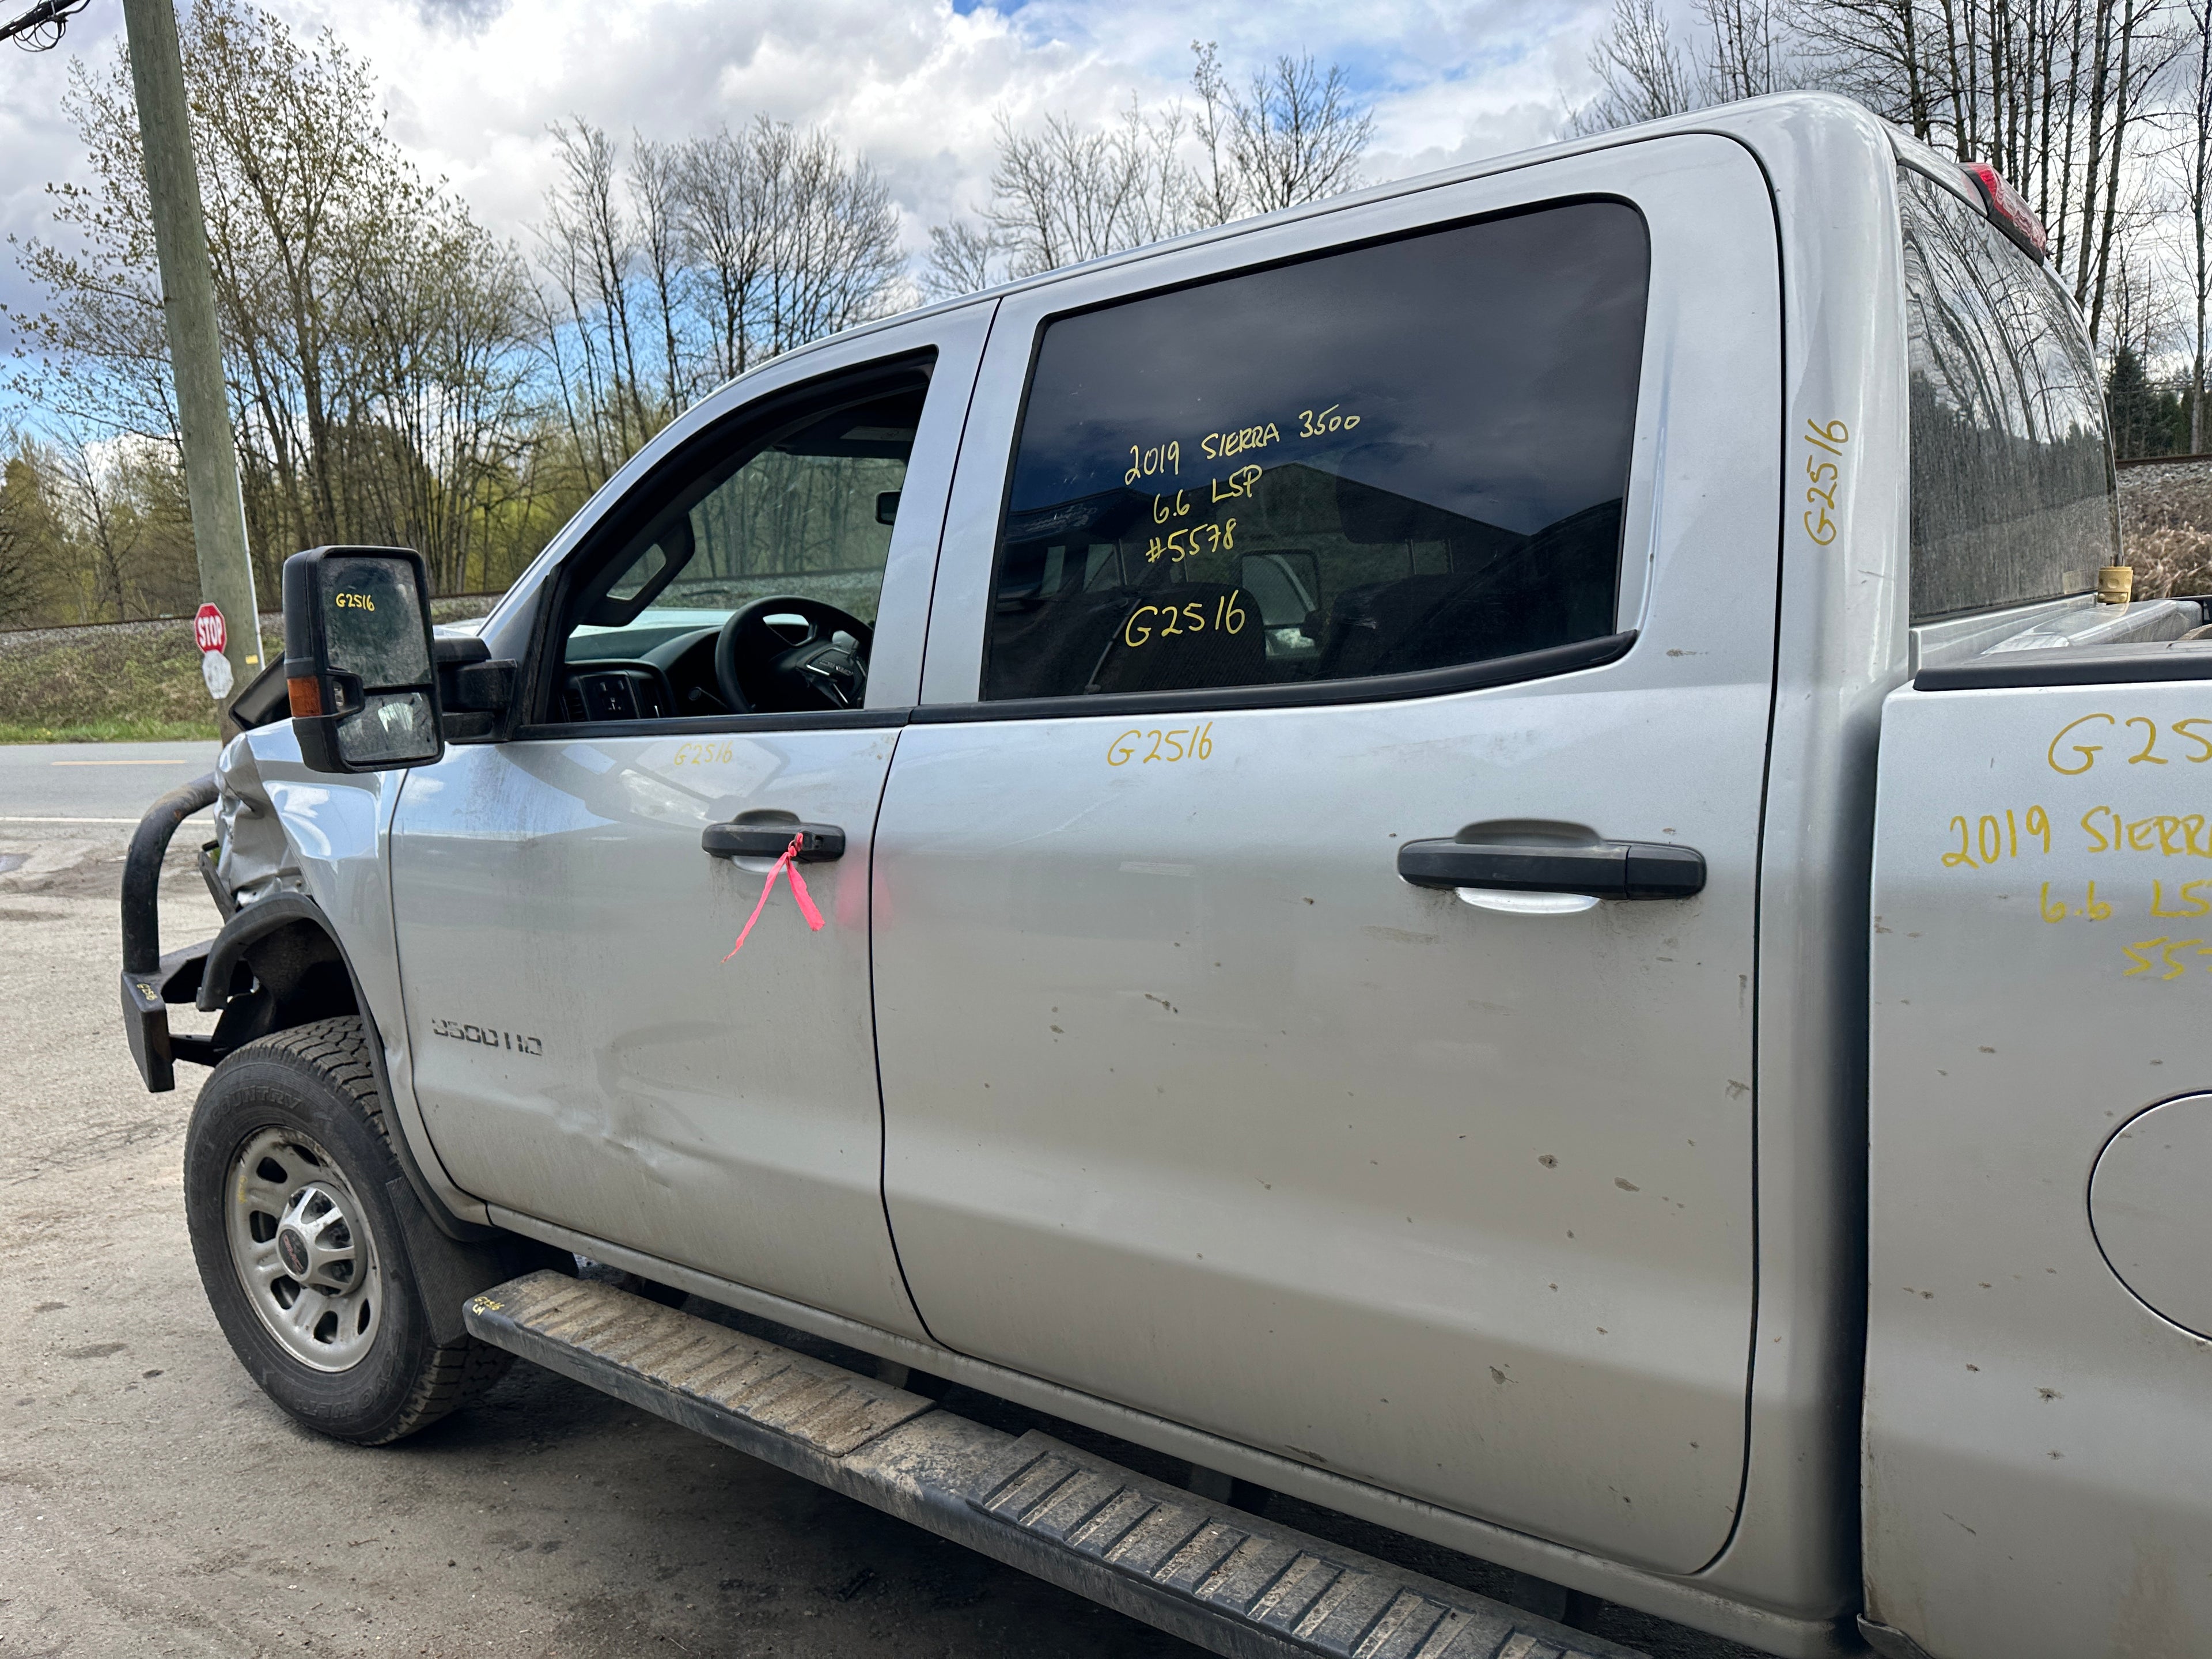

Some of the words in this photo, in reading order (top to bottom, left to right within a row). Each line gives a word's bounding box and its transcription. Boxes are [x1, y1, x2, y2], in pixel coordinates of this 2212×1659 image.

[1124, 441, 1180, 486] 2019
[1200, 422, 1281, 460] SIERRA
[1298, 404, 1361, 439] 3500
[1153, 488, 1191, 524] 6.6
[1211, 464, 1263, 503] LSP
[1804, 418, 1849, 546] G2516
[1146, 518, 1237, 563] #5578
[336, 593, 375, 612] G2516
[1125, 590, 1246, 647] G2516
[198, 615, 223, 648] STOP
[673, 740, 733, 766] G2516
[1107, 721, 1213, 766] G2516
[1941, 805, 2051, 869] 2019
[2081, 805, 2212, 859] SIERR
[2039, 880, 2112, 923] 6.6
[2150, 878, 2212, 918] LS
